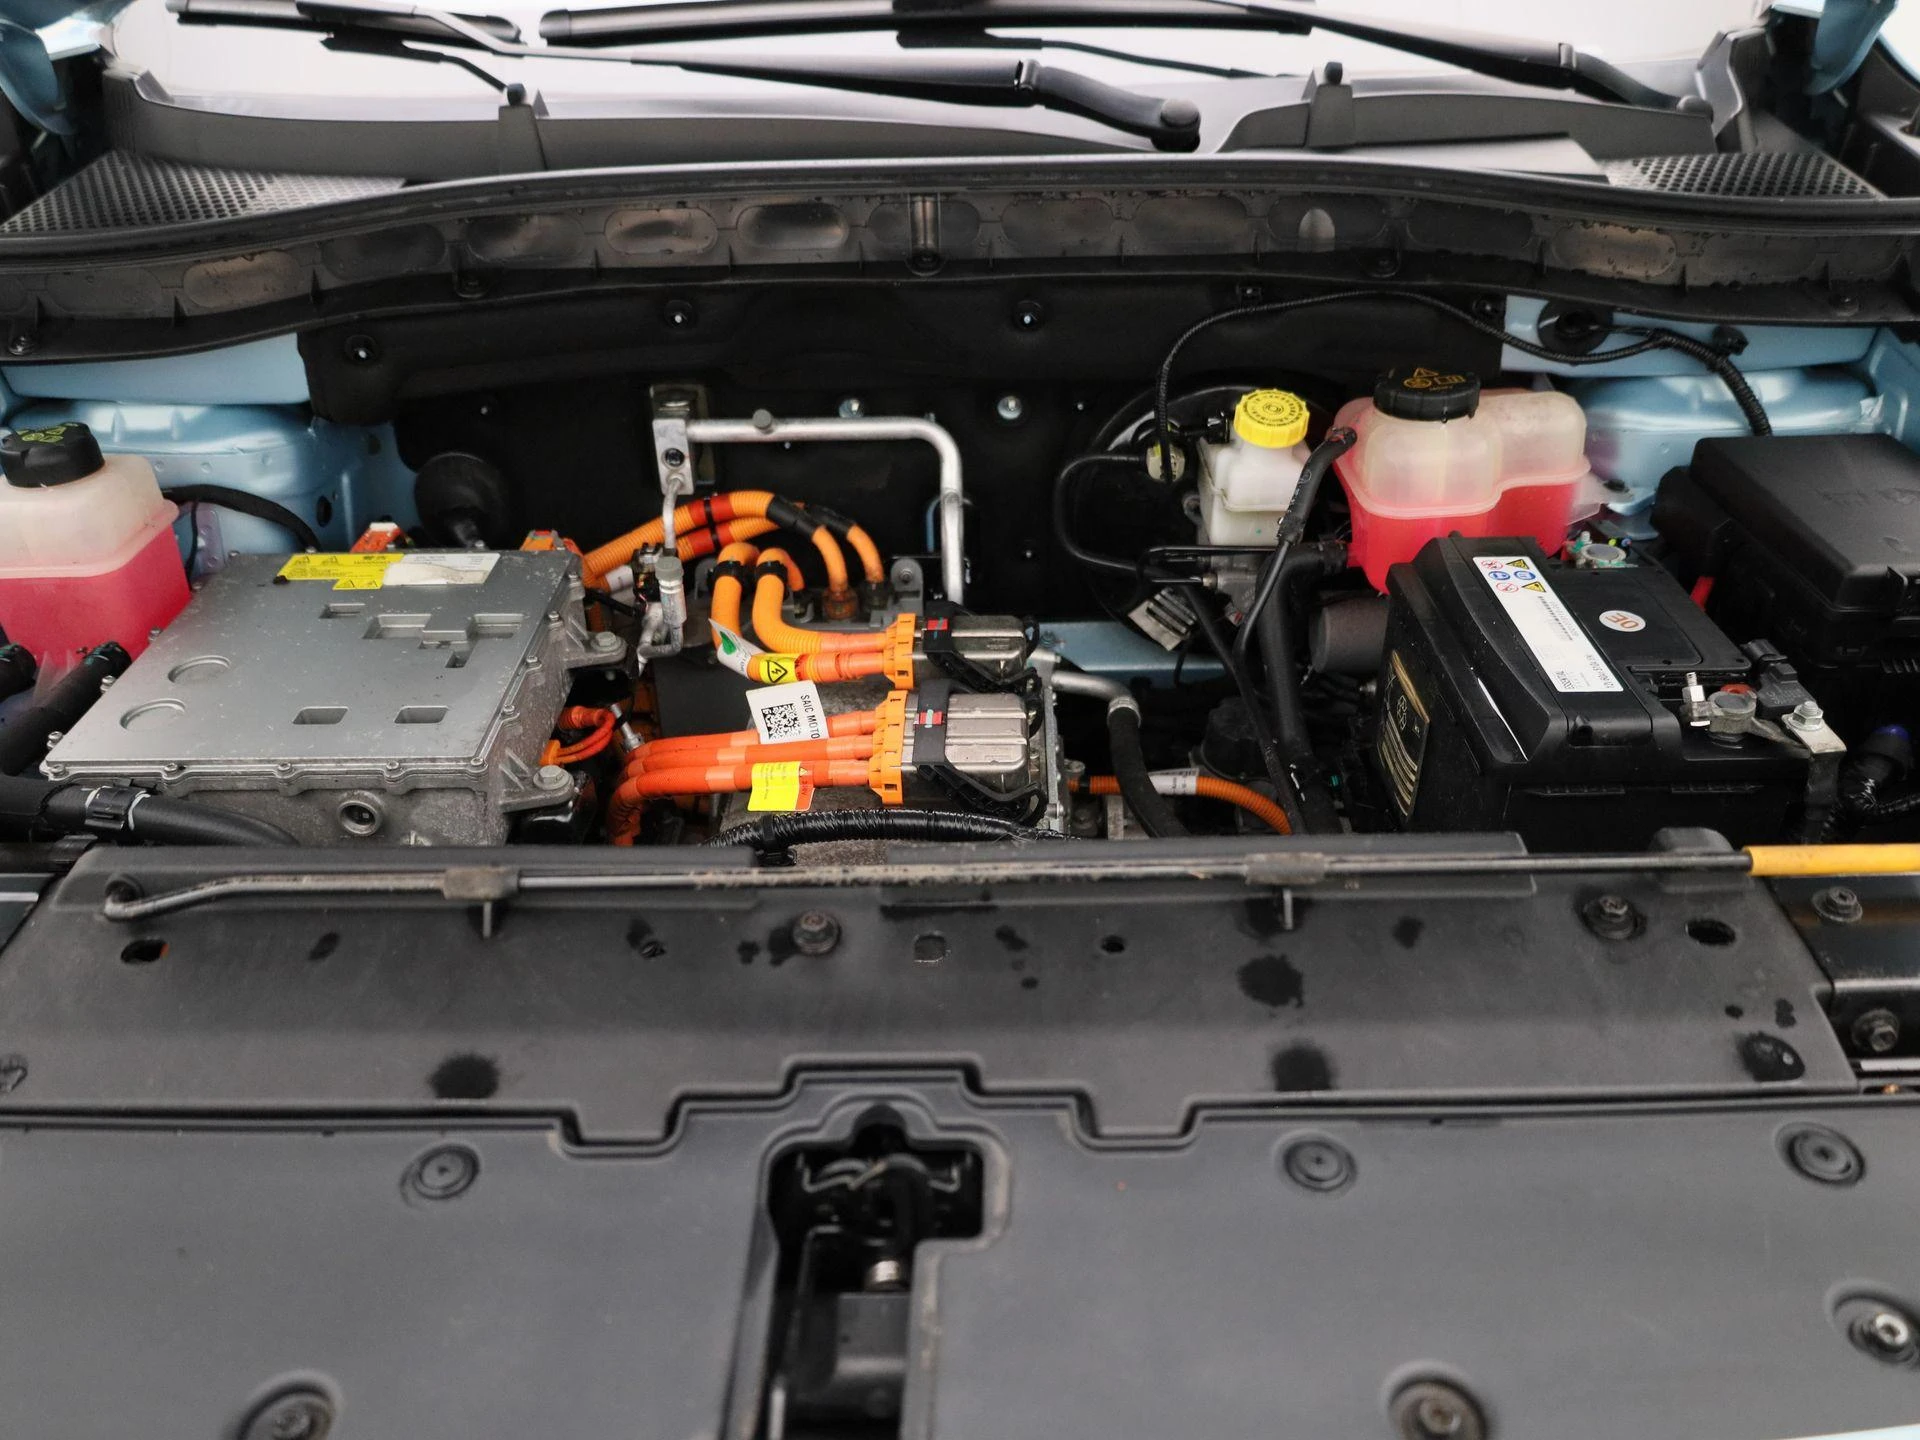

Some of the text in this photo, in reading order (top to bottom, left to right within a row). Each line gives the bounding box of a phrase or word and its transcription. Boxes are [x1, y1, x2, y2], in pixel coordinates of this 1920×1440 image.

[1605, 612, 1640, 629] OE
[801, 694, 820, 739] SAIC MOTO
